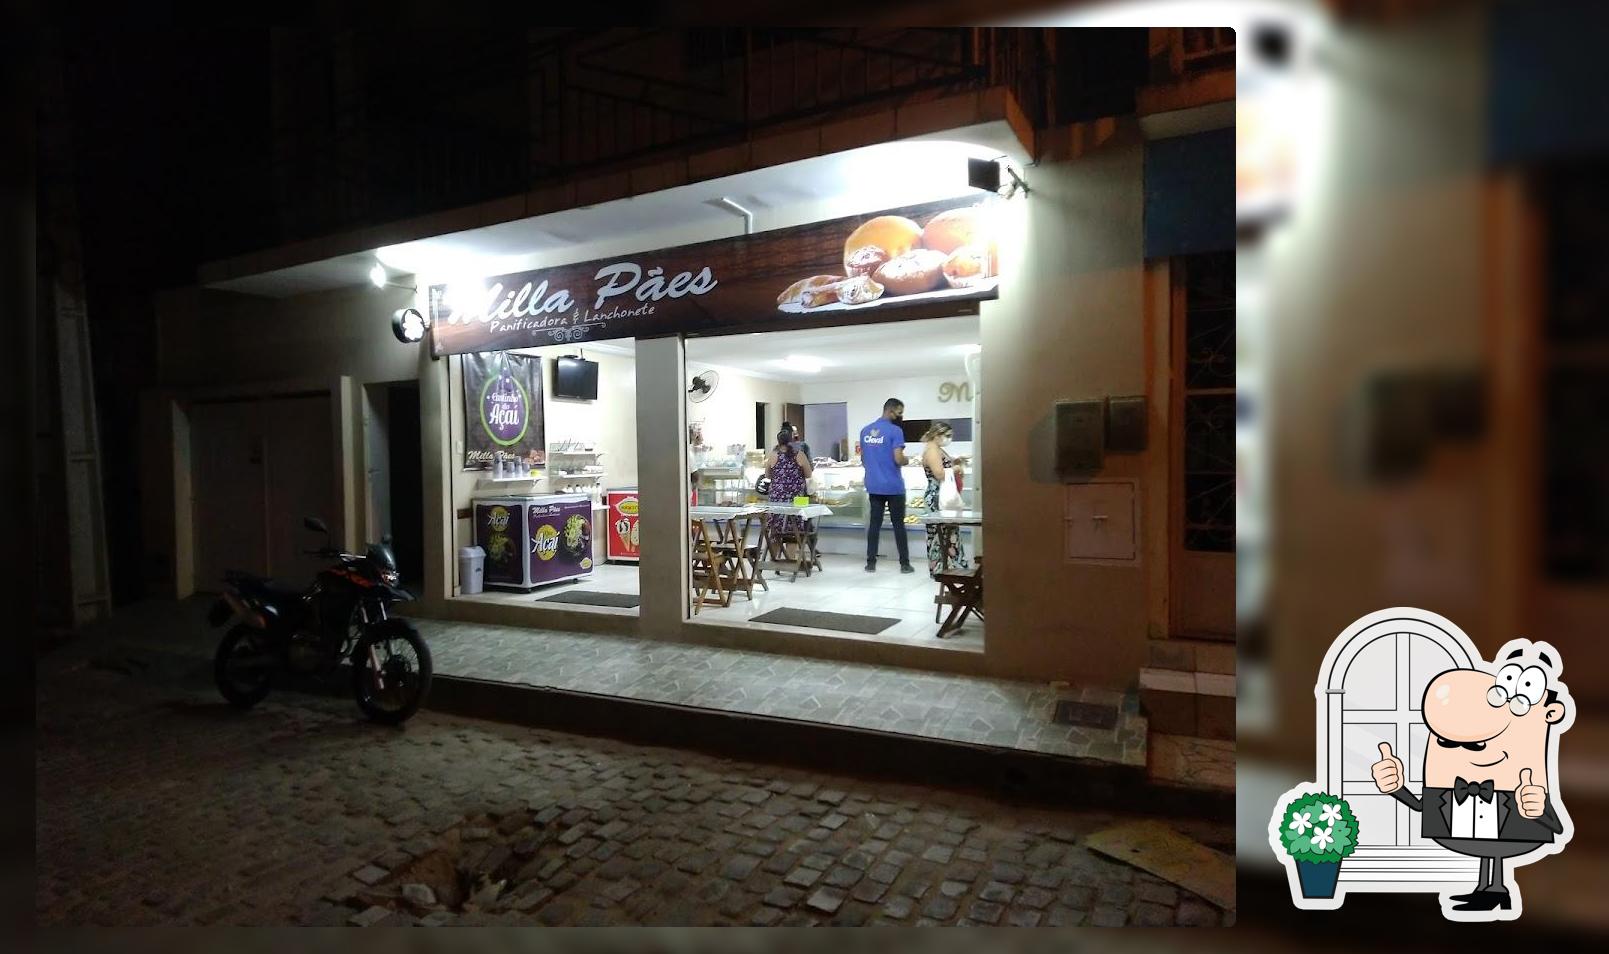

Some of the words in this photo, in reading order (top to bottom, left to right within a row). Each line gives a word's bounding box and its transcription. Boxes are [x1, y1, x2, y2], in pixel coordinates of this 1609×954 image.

[594, 261, 718, 310] Pães
[489, 316, 568, 333] Panificadora
[583, 305, 656, 323] Lanchonete
[489, 404, 520, 430] Açaí
